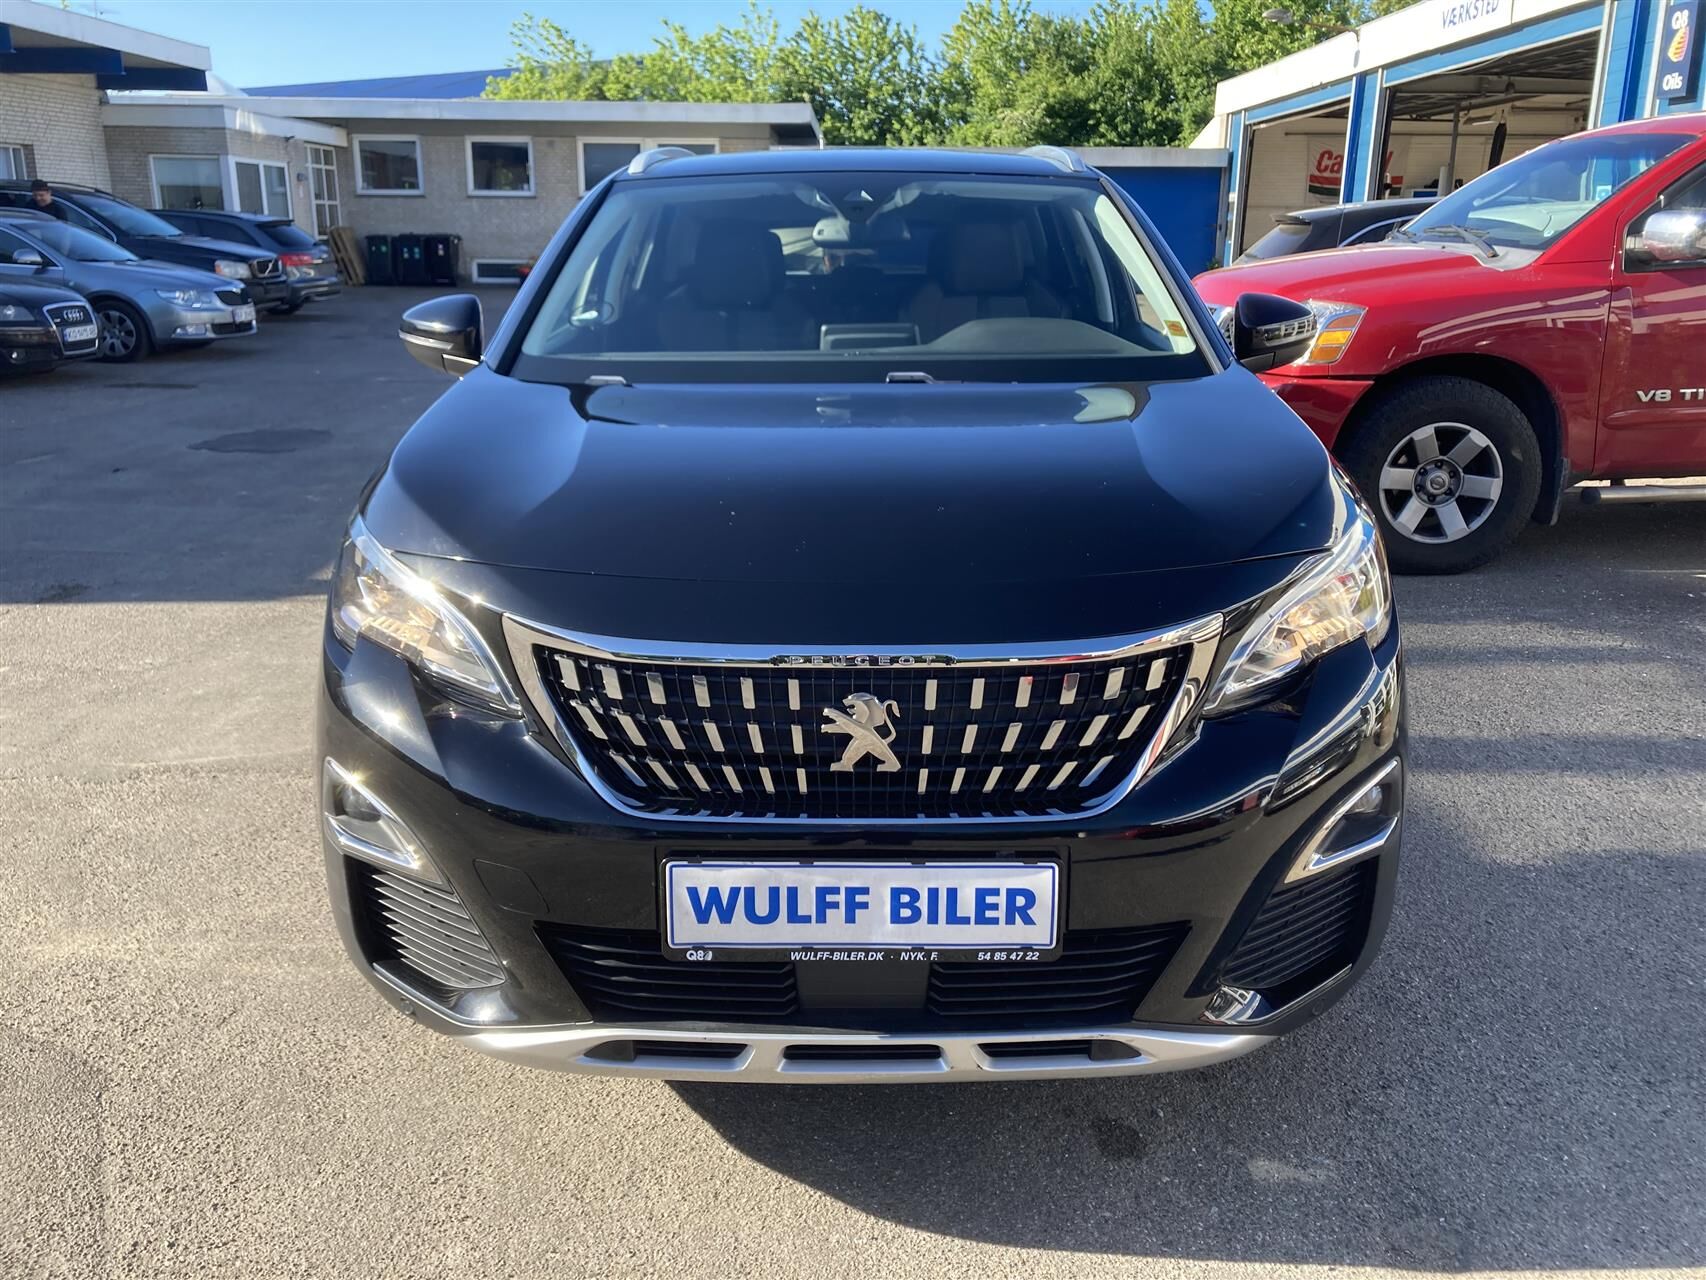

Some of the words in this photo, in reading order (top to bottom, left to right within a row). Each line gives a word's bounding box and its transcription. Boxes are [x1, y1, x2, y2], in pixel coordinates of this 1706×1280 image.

[1442, 0, 1499, 29] VÆRKSTED
[1672, 9, 1689, 30] Q8
[1662, 72, 1683, 91] Oils
[1636, 389, 1672, 403] V8
[1679, 388, 1706, 401] TI
[785, 655, 937, 666] PEUGEOT
[686, 886, 870, 924] WULFF
[889, 886, 1037, 926] BILER
[686, 950, 704, 961] Q8
[789, 951, 885, 961] WULFF-BILER.DK
[900, 951, 927, 961] NYK.
[977, 951, 991, 961] 54
[993, 951, 1007, 961] 85
[1010, 951, 1024, 961] 47
[1025, 951, 1040, 961] 22
